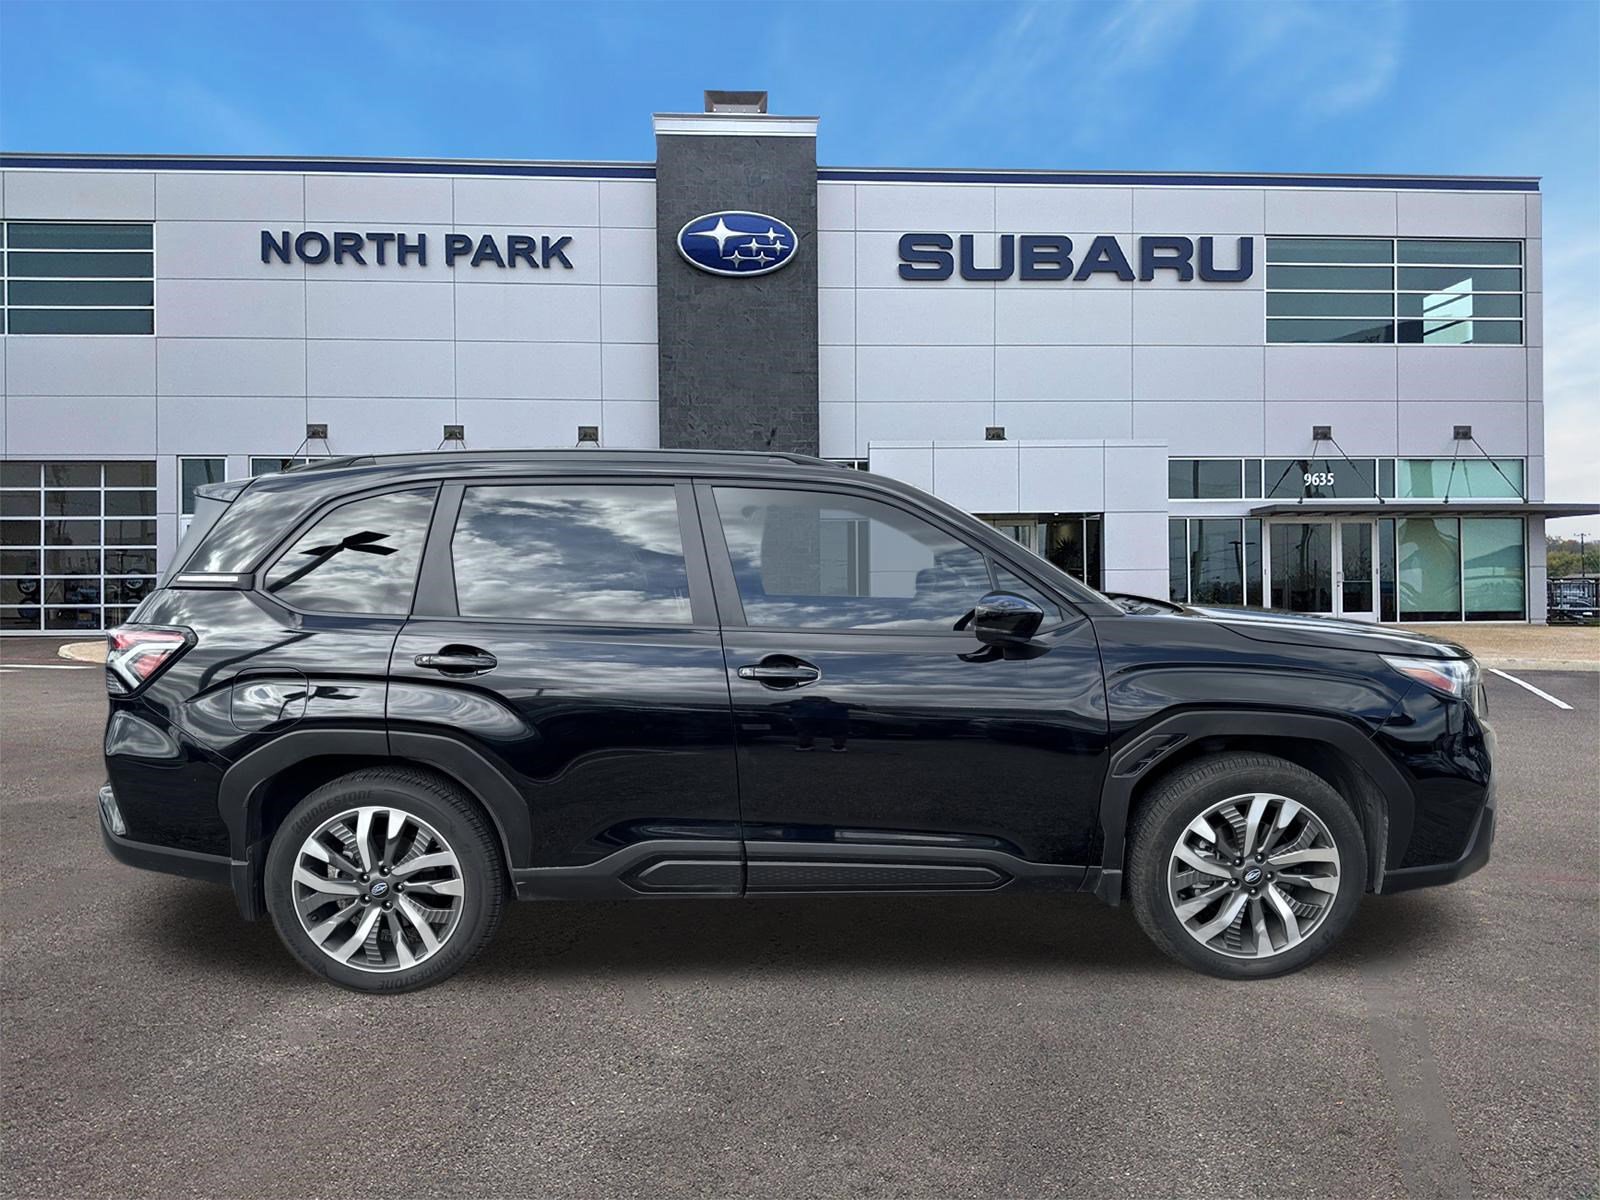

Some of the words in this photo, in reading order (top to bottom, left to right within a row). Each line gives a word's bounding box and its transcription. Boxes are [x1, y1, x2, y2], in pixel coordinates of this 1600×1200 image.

[260, 230, 428, 267] NORTH
[444, 233, 574, 269] PARK
[898, 232, 1255, 283] SUBARU
[1303, 472, 1335, 486] 9635
